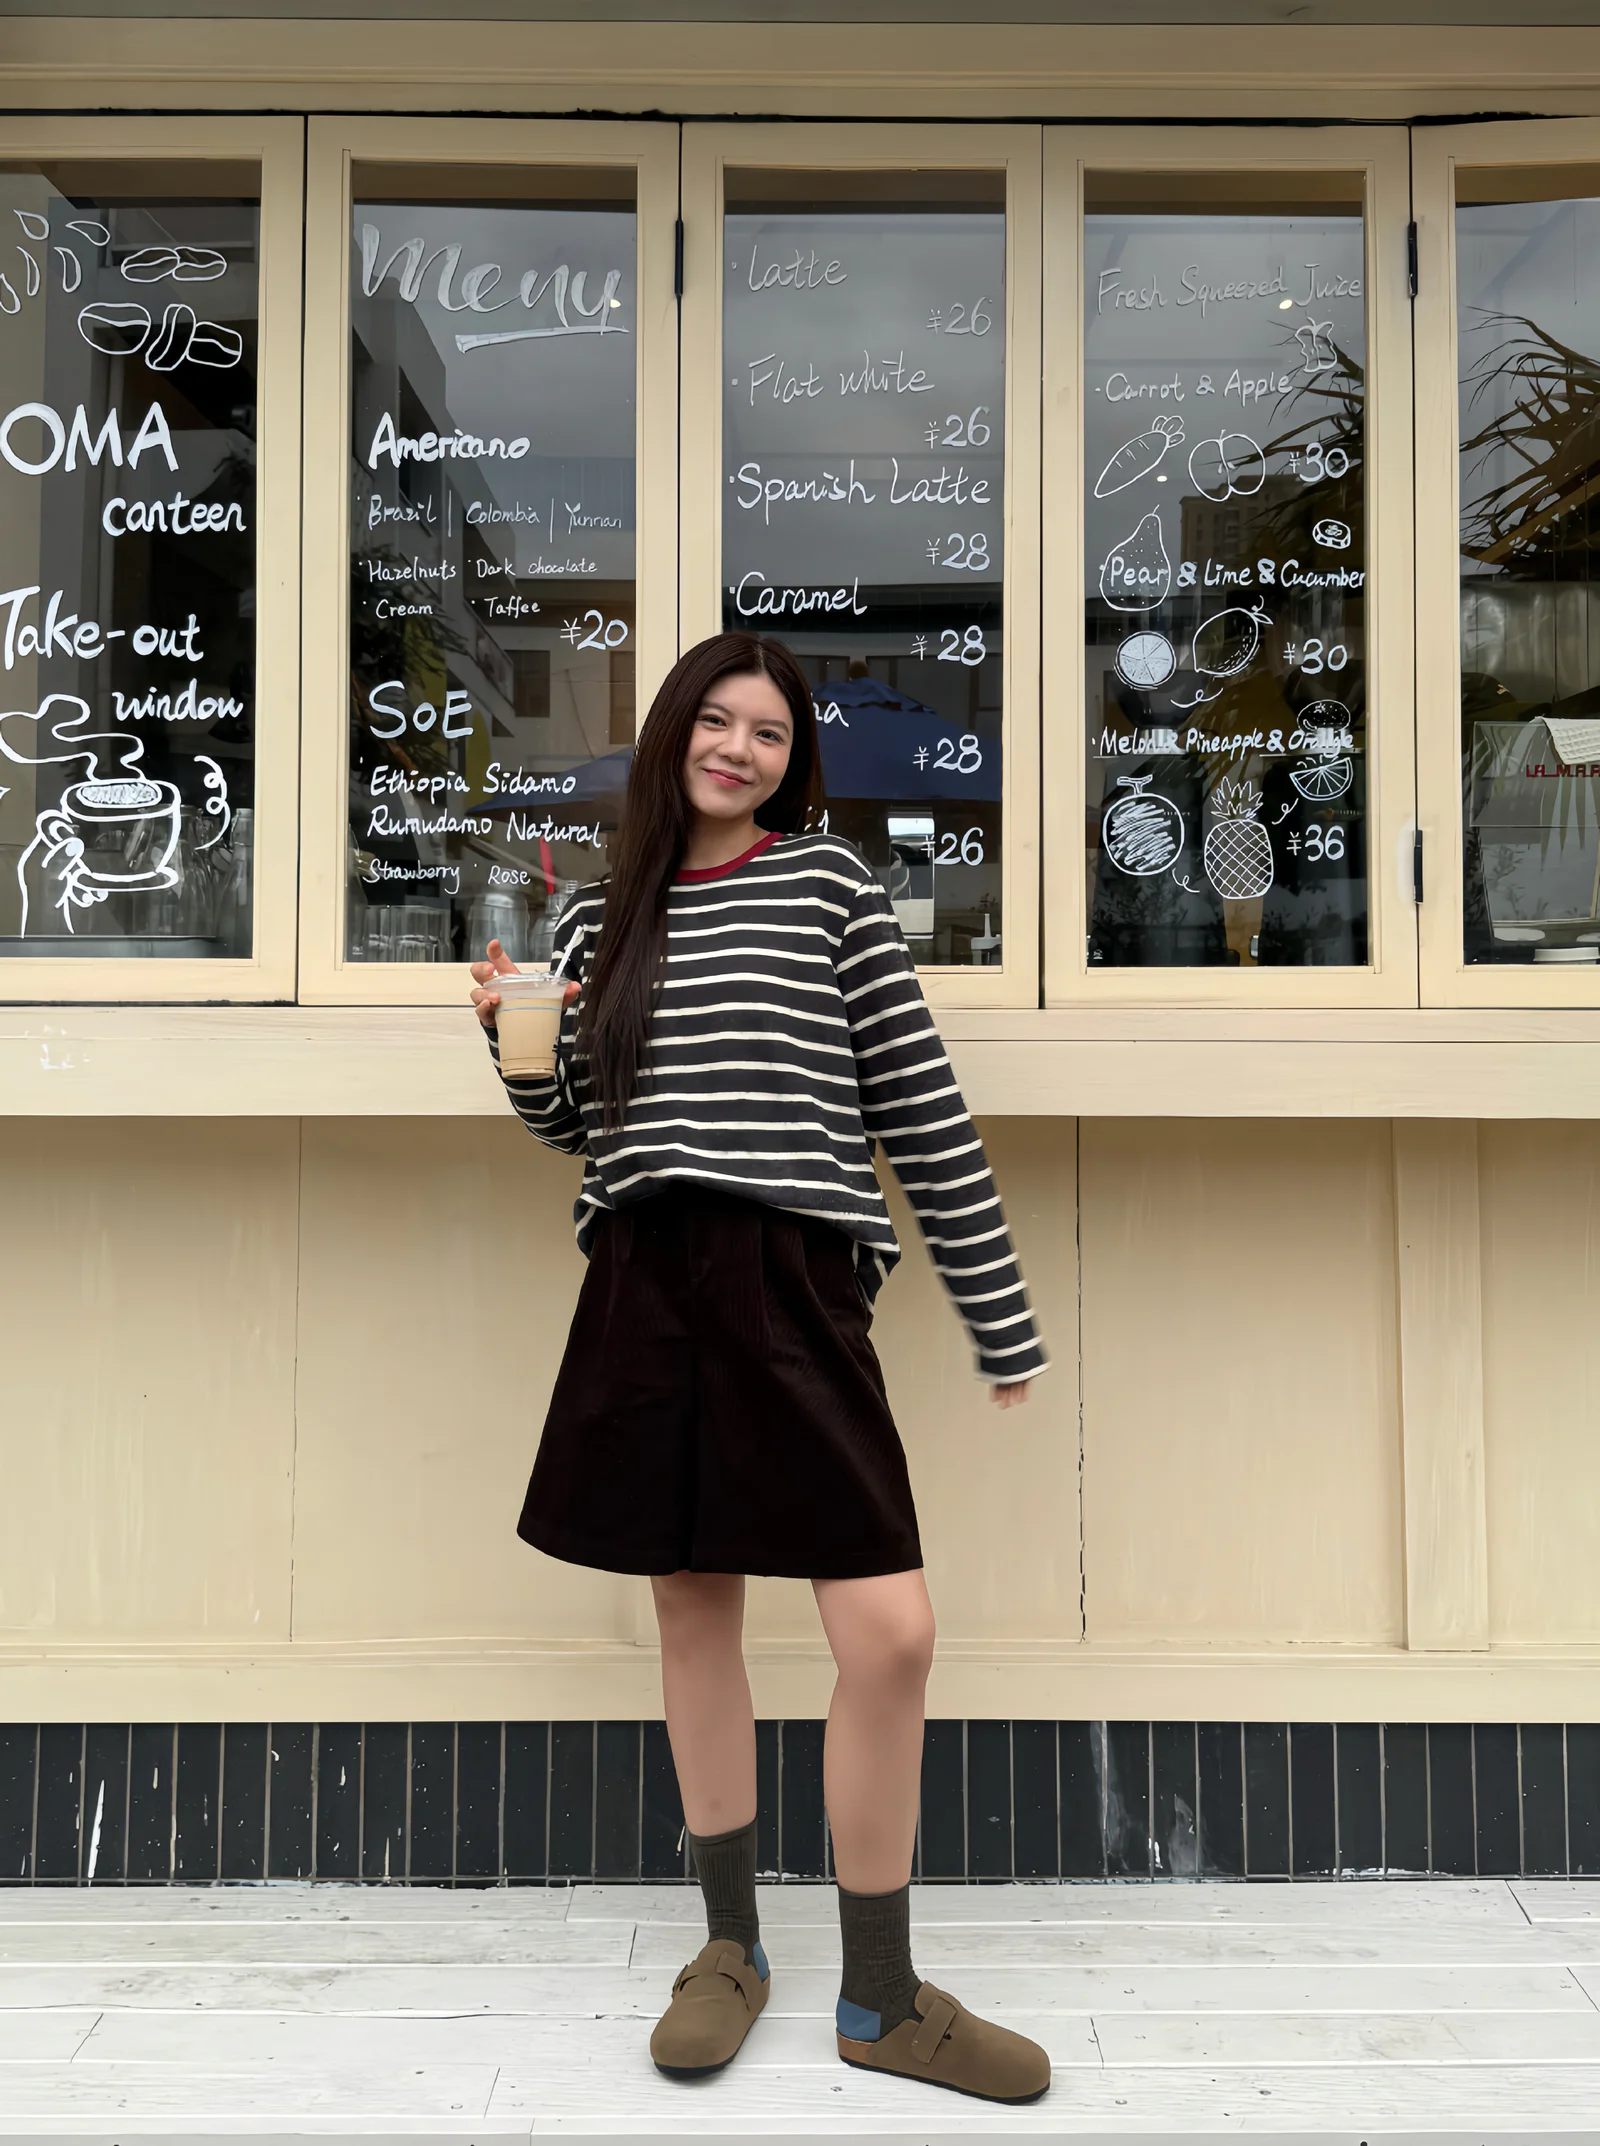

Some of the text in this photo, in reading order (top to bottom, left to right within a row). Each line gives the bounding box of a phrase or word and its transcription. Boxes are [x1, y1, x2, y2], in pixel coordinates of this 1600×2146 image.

[1098, 263, 1362, 318] Fresh Squeezed Juice
[926, 297, 993, 337] ¥26
[749, 350, 935, 406] Flat white
[1106, 369, 1293, 406] Carrot & Apple
[0, 402, 179, 475] OMA
[368, 411, 531, 470] Americano
[924, 406, 991, 449] ¥26
[1289, 442, 1349, 483] ¥30
[737, 458, 876, 525] Spanish
[103, 492, 247, 536] canteen
[368, 494, 622, 535] Brazil Colombia Yunnan
[367, 556, 598, 582] Hazelnuts Dark chocolate
[925, 532, 990, 571] ¥28
[736, 571, 868, 616] Caramel
[1110, 555, 1366, 592] Pear & Lime & Cucumber
[0, 585, 204, 670] Take-out
[376, 596, 541, 619] Cream Taffee
[560, 609, 629, 650] ¥20
[910, 624, 987, 667] ¥28
[1283, 638, 1347, 675] ¥30
[112, 678, 243, 721] window
[913, 734, 983, 774] ¥28
[1185, 727, 1263, 760] Pineapple
[1266, 728, 1285, 754] &
[370, 762, 577, 805] Ethiopia Sidamo
[367, 804, 602, 848] Rumudamo Natural
[1287, 824, 1345, 862] ¥36
[363, 858, 531, 895] Strawberry Rose
